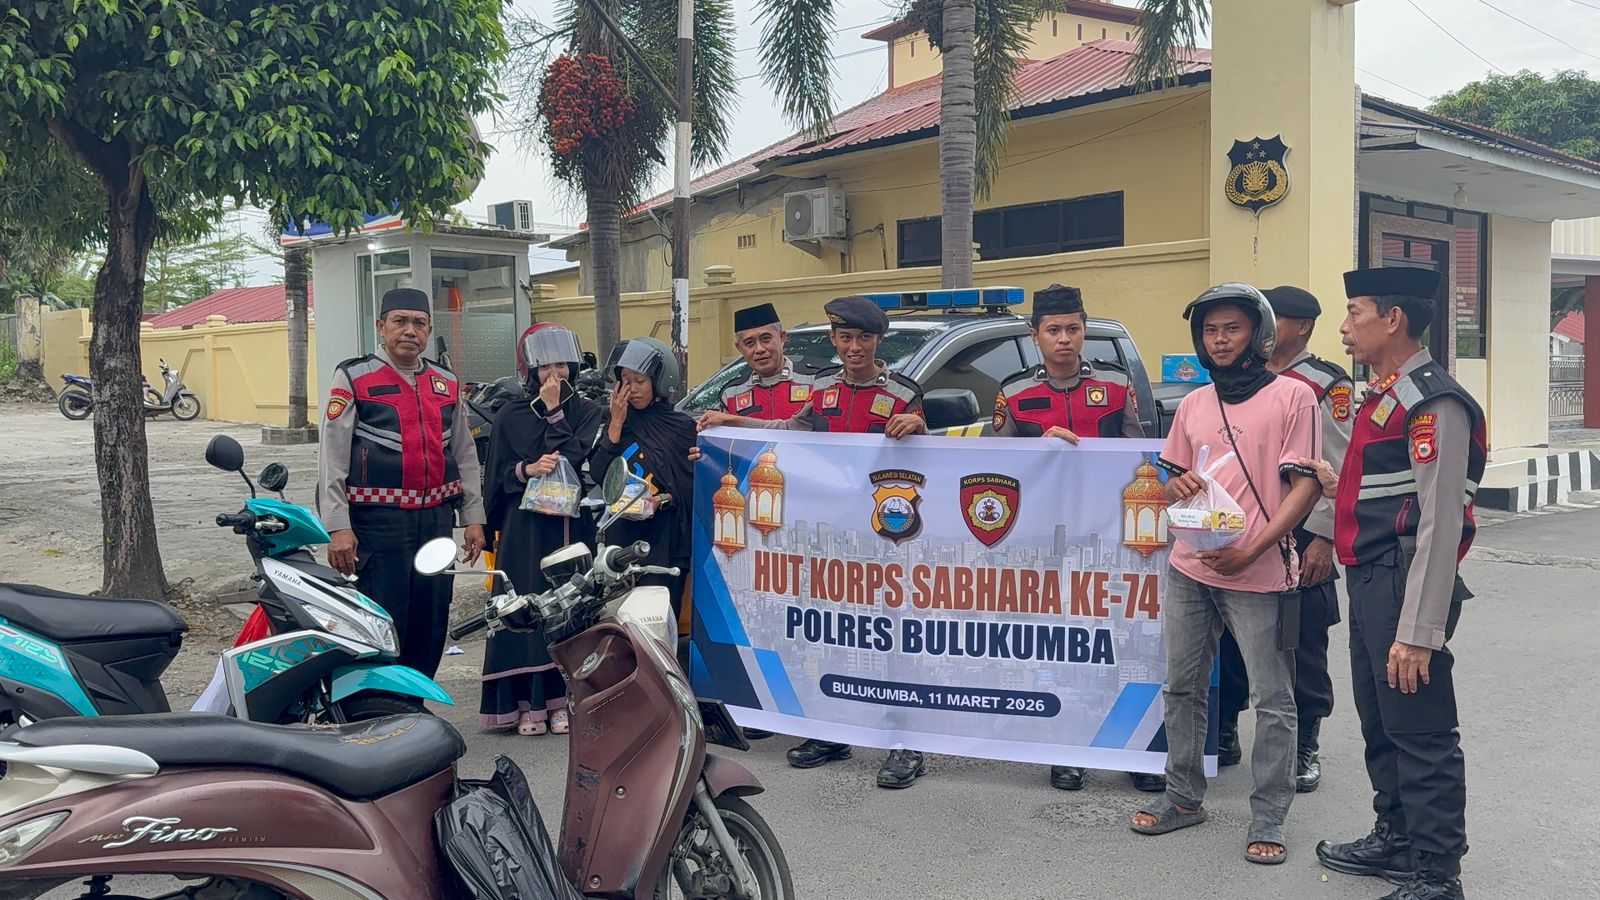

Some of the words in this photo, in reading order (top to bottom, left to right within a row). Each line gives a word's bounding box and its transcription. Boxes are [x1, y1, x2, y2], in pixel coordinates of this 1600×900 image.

[872, 471, 899, 483] SULAWESI
[898, 471, 922, 483] SELATAN
[963, 477, 986, 486] KORPS
[986, 477, 1016, 488] SABHARA
[274, 569, 302, 586] YAMAHA
[754, 550, 804, 597] HUT
[810, 556, 904, 608] KORPS
[912, 564, 1062, 615] SABHARA
[1070, 570, 1161, 620] KE-74
[639, 615, 664, 623] YAMAHA
[786, 605, 893, 652] POLRES
[901, 618, 1116, 665] BULUKUMBA
[832, 681, 923, 705] BULUKUMBA,
[928, 692, 942, 704] 11
[947, 693, 1000, 709] MARET
[1005, 697, 1045, 712] 2026
[102, 816, 238, 849] Fino
